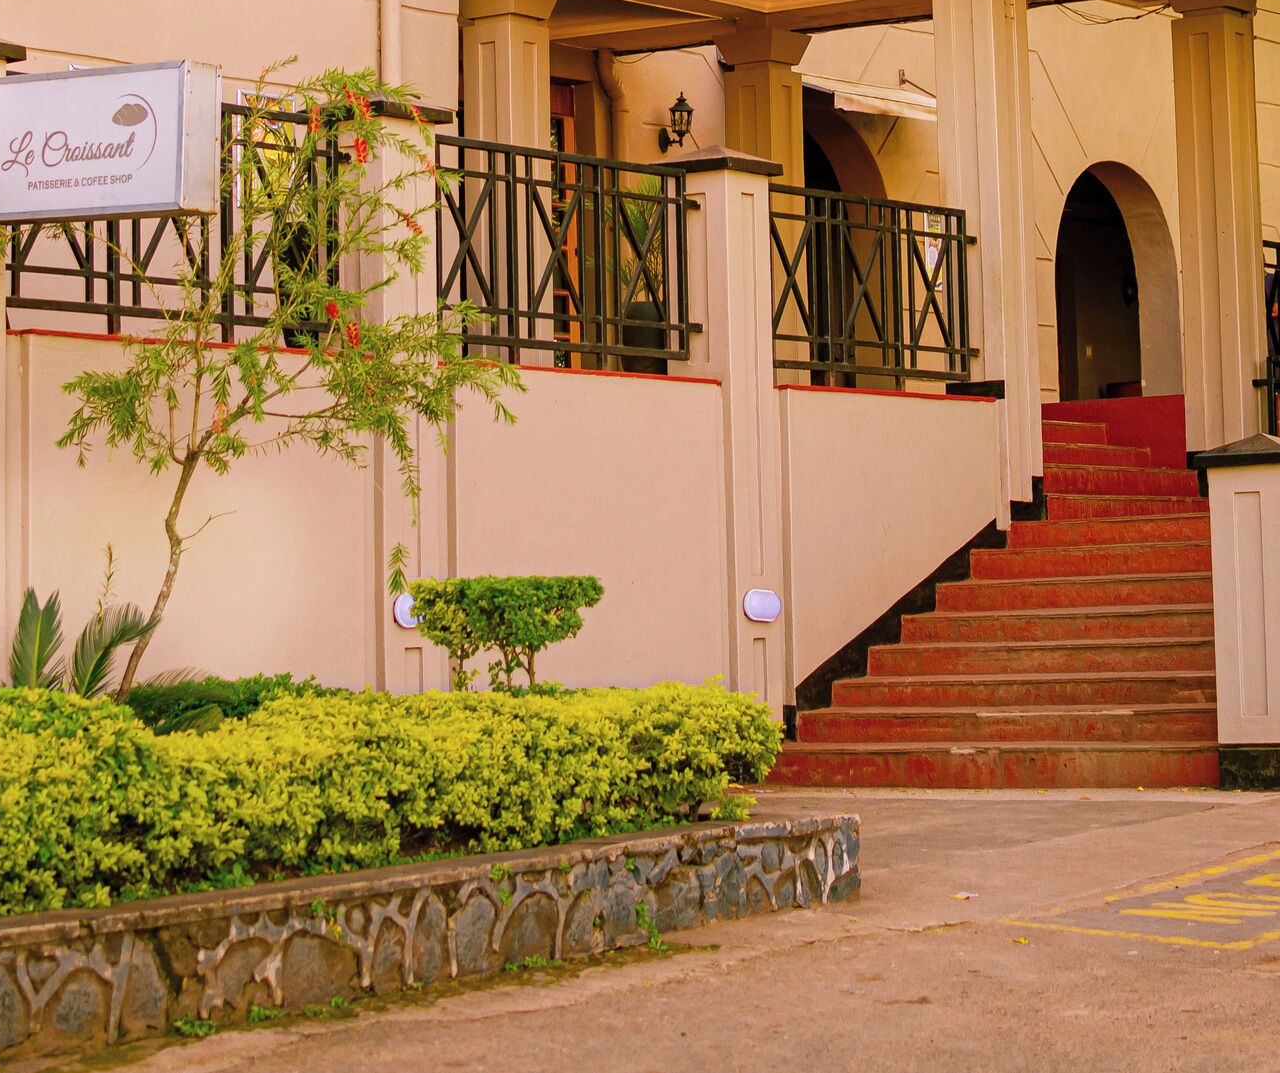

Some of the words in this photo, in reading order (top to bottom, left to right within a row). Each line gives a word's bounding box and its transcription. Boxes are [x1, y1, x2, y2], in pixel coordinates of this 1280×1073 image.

[1, 130, 35, 177] Le
[41, 130, 136, 167] Croissant
[27, 178, 73, 191] PATISSERIE
[74, 178, 79, 188] &
[81, 175, 109, 187] COFEE
[110, 173, 133, 184] SHOP
